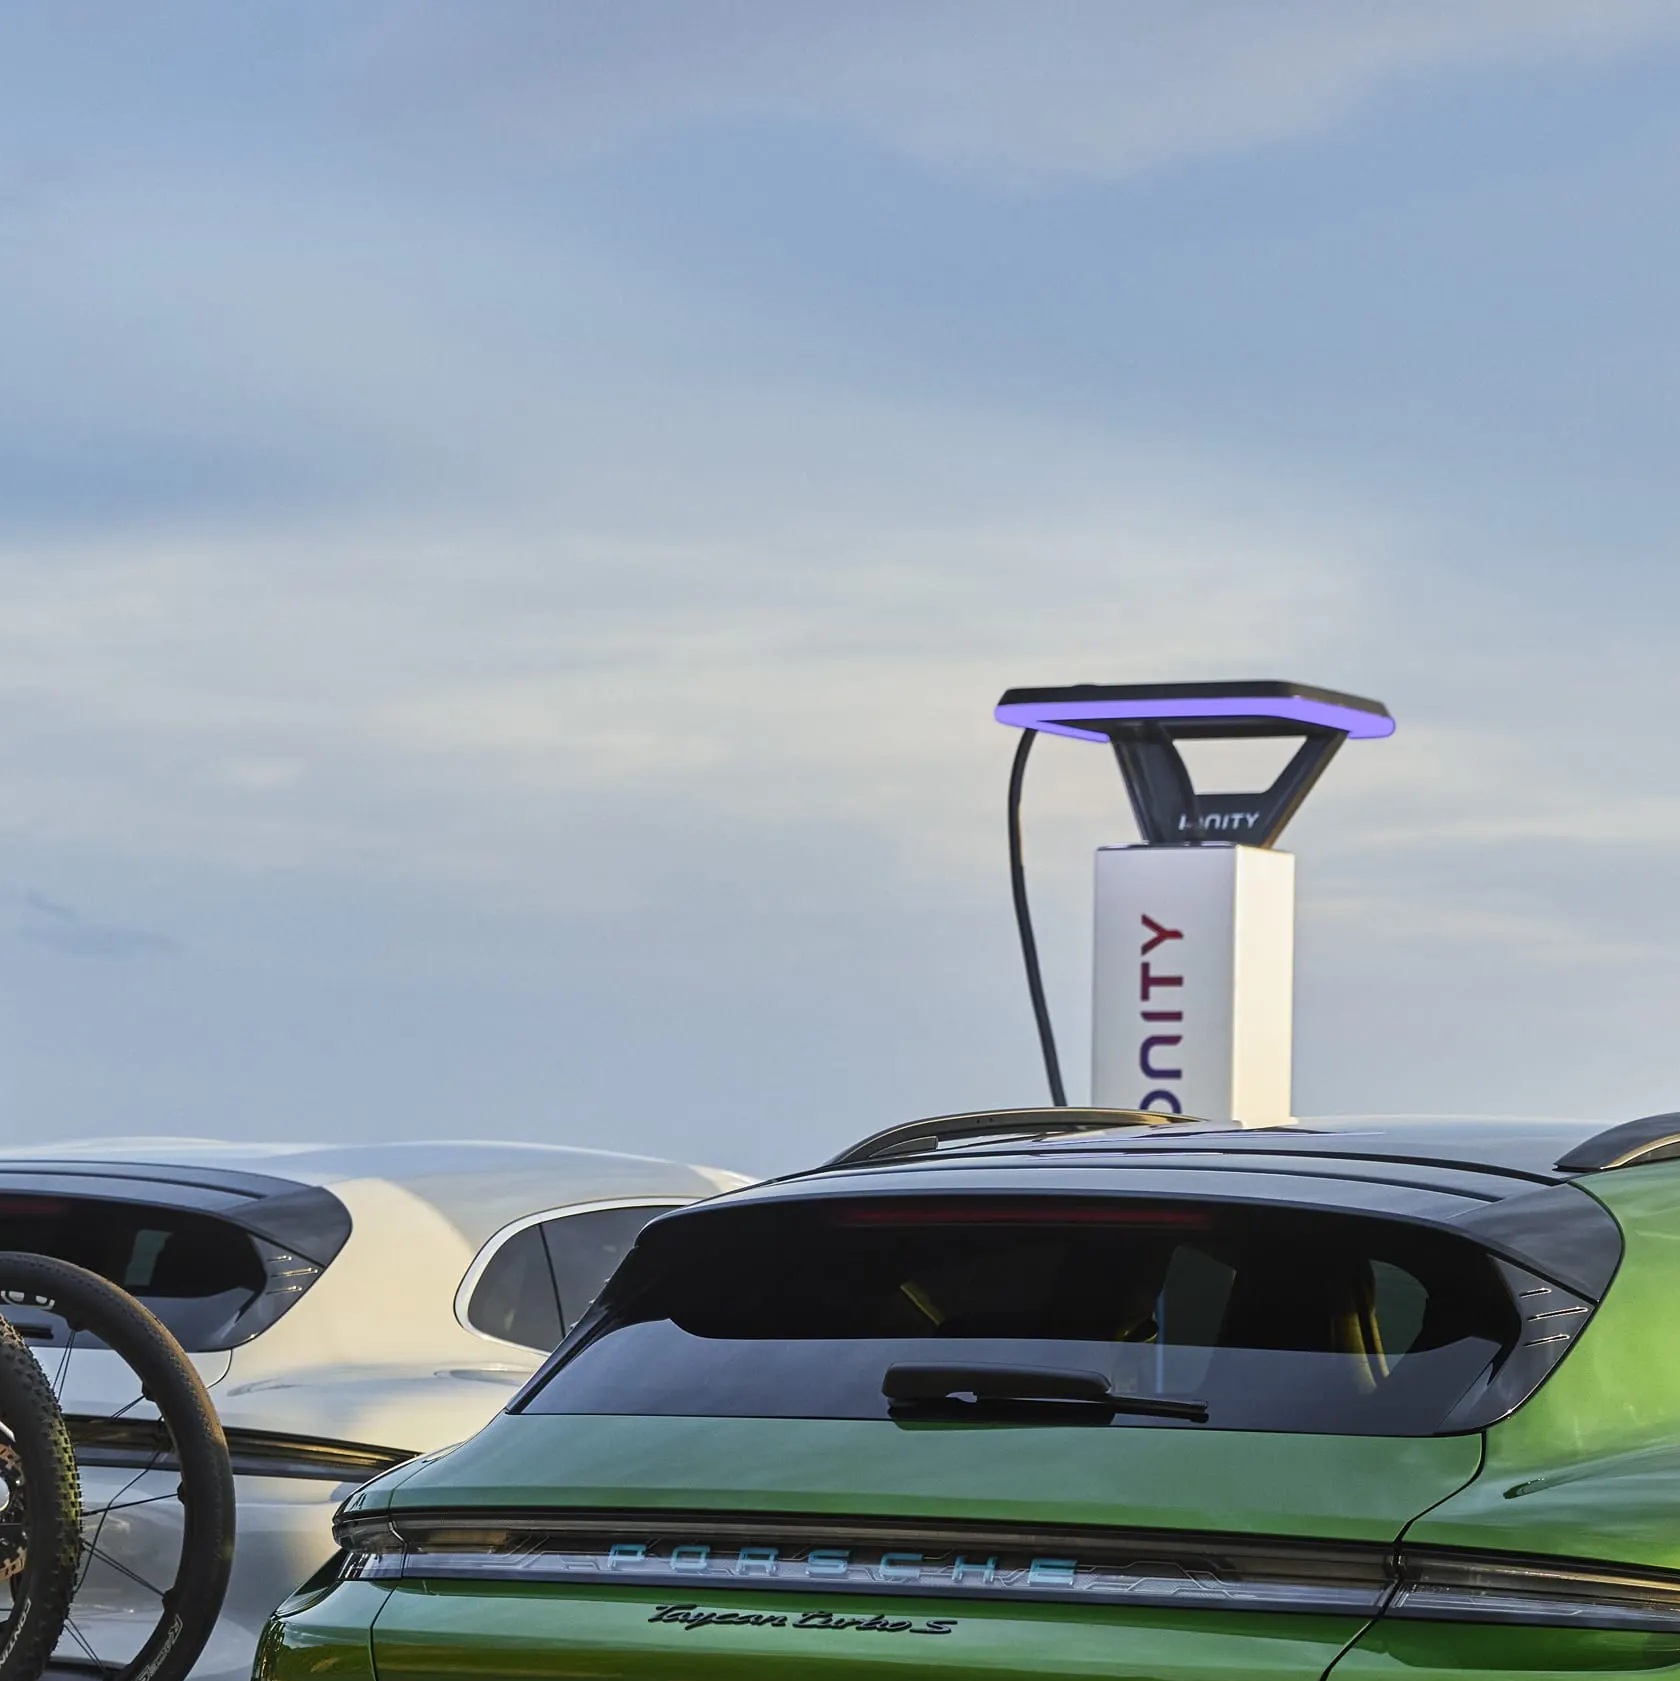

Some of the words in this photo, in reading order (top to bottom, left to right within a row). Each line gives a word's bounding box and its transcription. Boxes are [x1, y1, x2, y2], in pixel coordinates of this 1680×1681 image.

[1178, 811, 1260, 831] INITY
[1139, 913, 1184, 1116] ONITY
[607, 1543, 1078, 1587] PORSCHE
[648, 1603, 788, 1631] Taycan
[792, 1610, 912, 1632] Turbo
[908, 1619, 958, 1635] S
